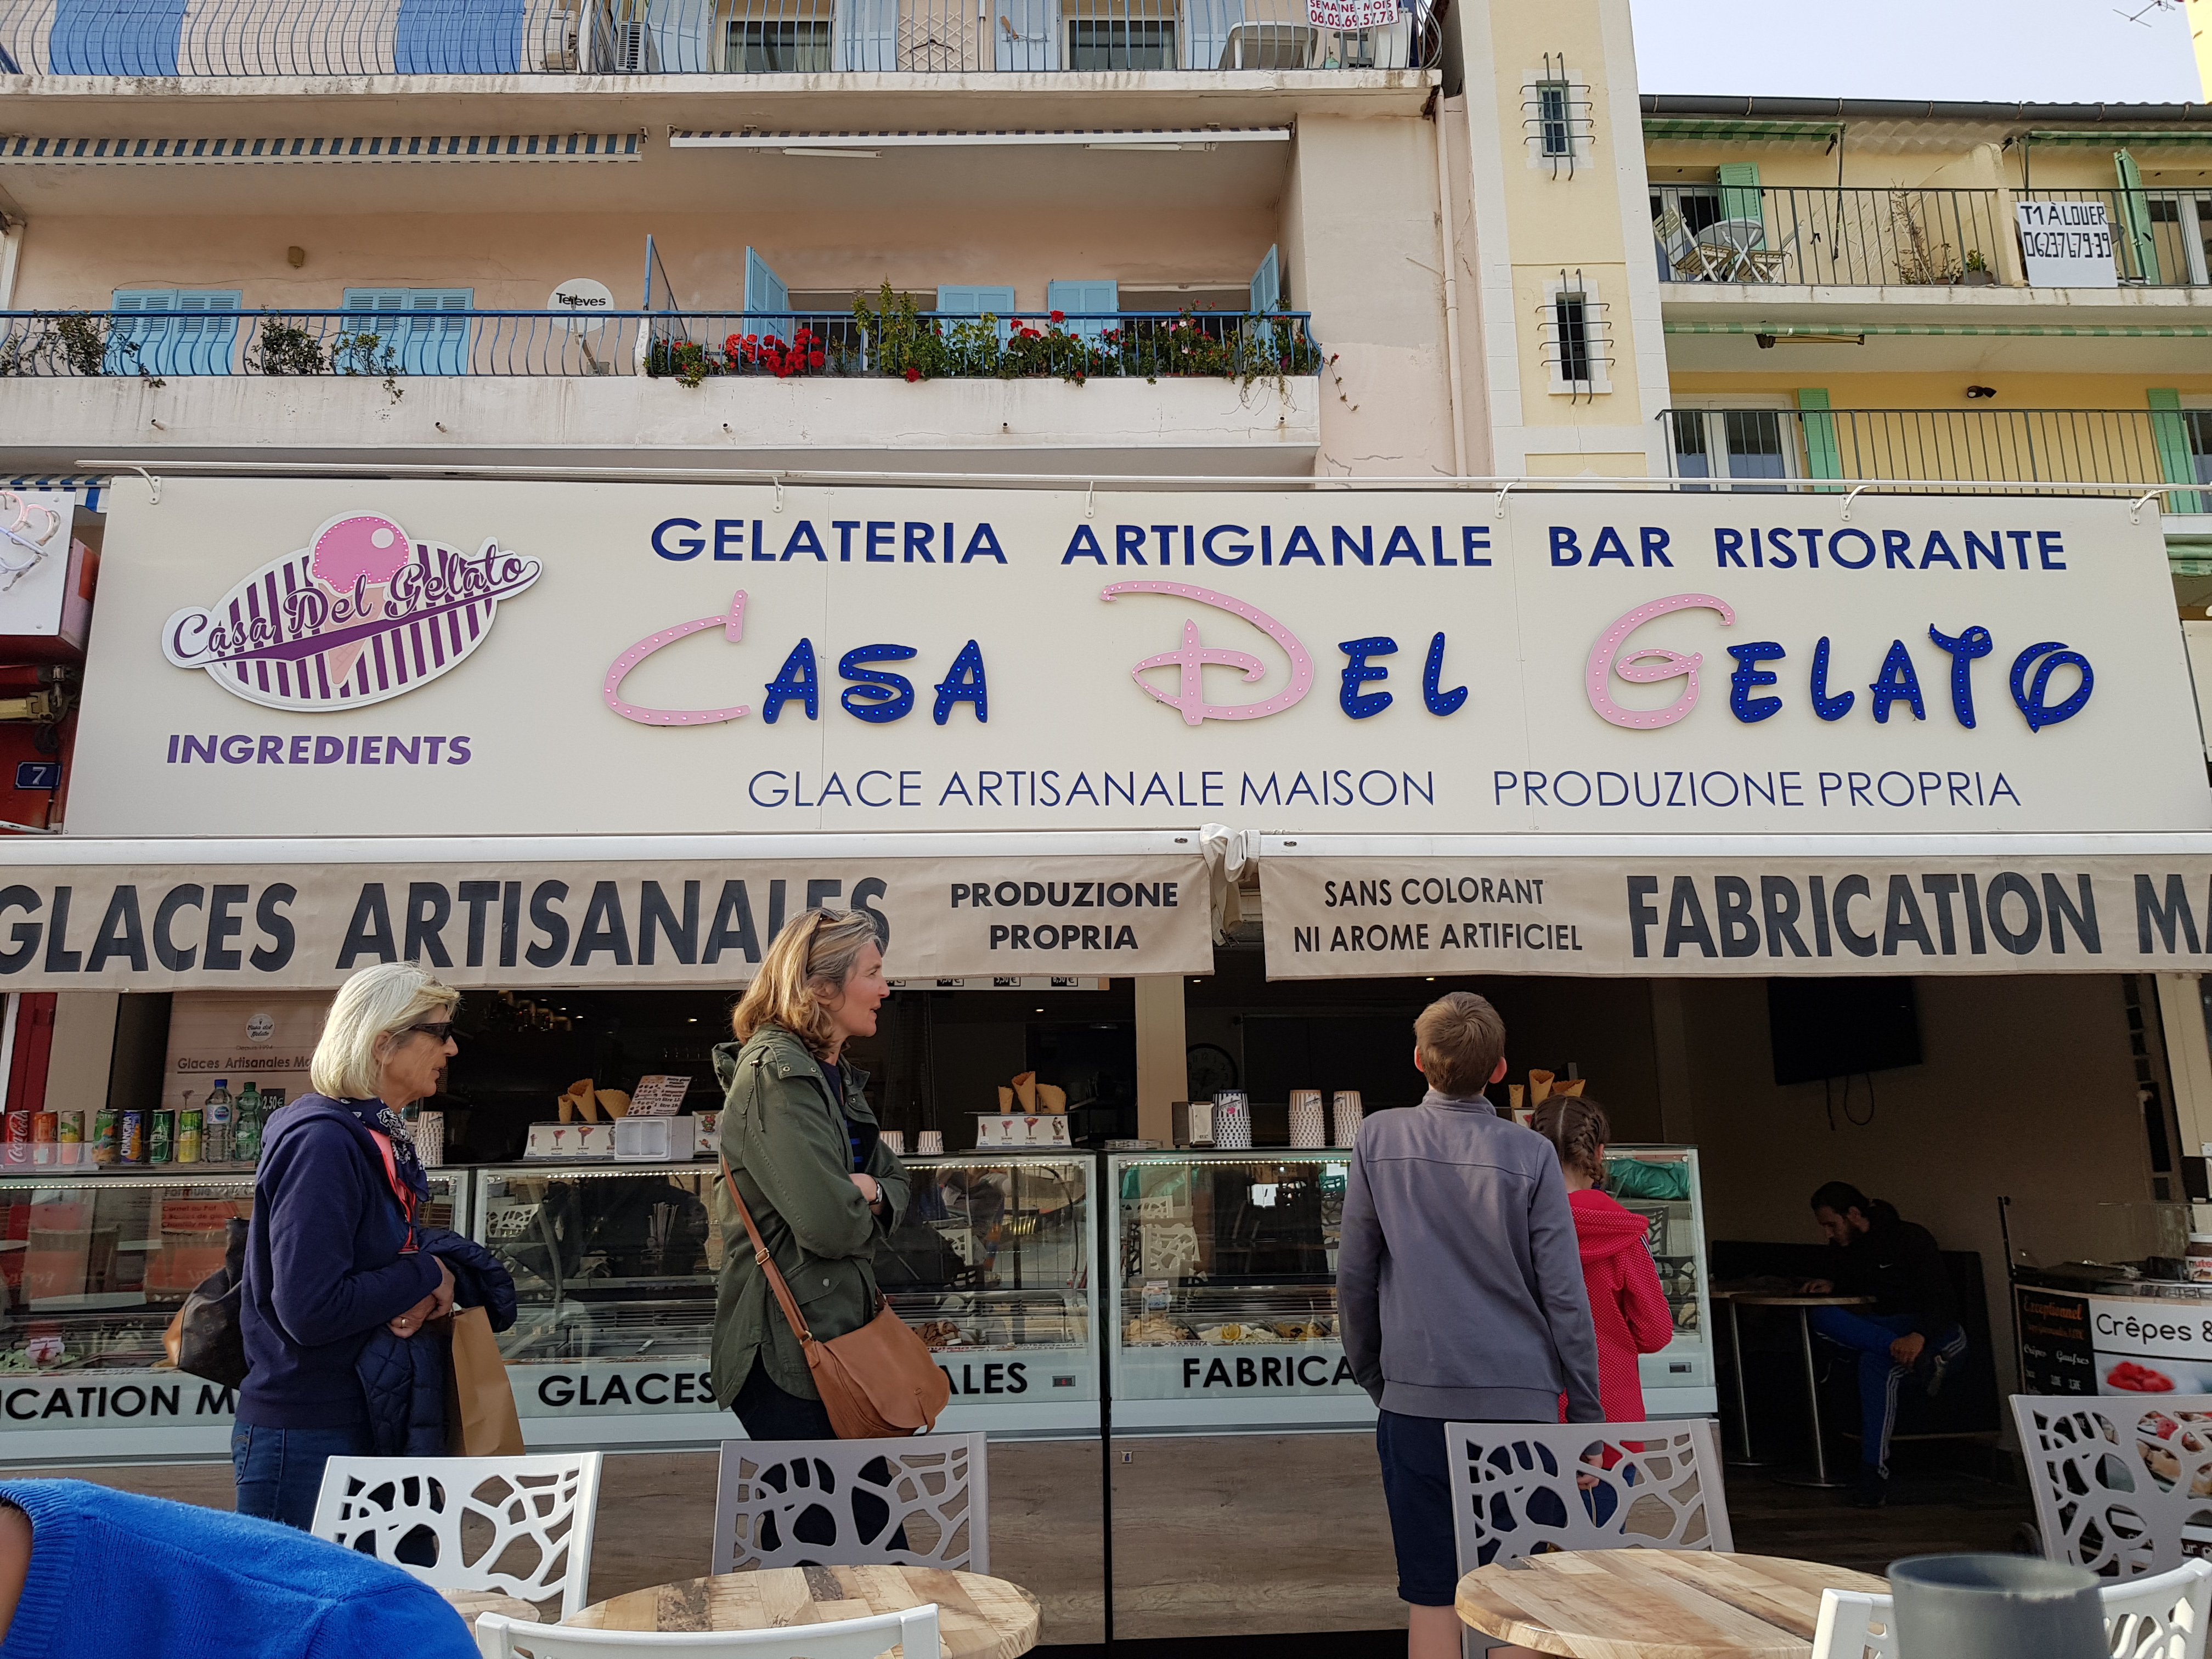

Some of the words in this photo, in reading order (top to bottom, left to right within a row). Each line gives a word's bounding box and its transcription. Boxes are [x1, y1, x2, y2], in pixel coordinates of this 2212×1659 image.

[1363, 1, 1392, 11] MOIS
[2021, 206, 2044, 225] T1
[2062, 206, 2108, 225] LOUER
[651, 518, 1008, 564] GELATERIA
[1060, 524, 1492, 567] ARTIGIANALE
[1548, 526, 1674, 568] BAR
[1714, 527, 2067, 570] RISTORANTE
[174, 614, 276, 659] Casa
[284, 574, 373, 634] Del
[385, 544, 540, 618] Gelato
[167, 735, 472, 765] INGREDIENTS
[31, 767, 47, 785] 7
[748, 770, 922, 808] GLACE
[938, 770, 1224, 807] ARTISANALE
[1240, 770, 1434, 806] MAISON
[1494, 770, 1804, 807] PRODUZIONE
[1819, 771, 2022, 806] PROPRIA
[951, 881, 1178, 909] PRODUZIONE
[1324, 879, 1392, 907] SANS
[1401, 877, 1545, 906] COLORANT
[0, 882, 297, 975] GLACES
[335, 876, 890, 969] ARTISANALS
[1626, 871, 2103, 958] FABRICATION
[2134, 874, 2212, 955] M
[990, 924, 1138, 950] PROPRIA
[1294, 926, 1319, 952] NI
[1330, 923, 1429, 952] AROME
[1440, 922, 1583, 951] ARTIFICIEL
[178, 1058, 219, 1069] Glaces
[225, 1056, 290, 1069] Artisanales
[121, 1116, 132, 1156] ORANGINA
[2096, 1313, 2192, 1344] Crêpes
[1183, 1355, 1359, 1388] FABRICA
[0, 1385, 180, 1420] CATION
[538, 1372, 718, 1407] GLACES
